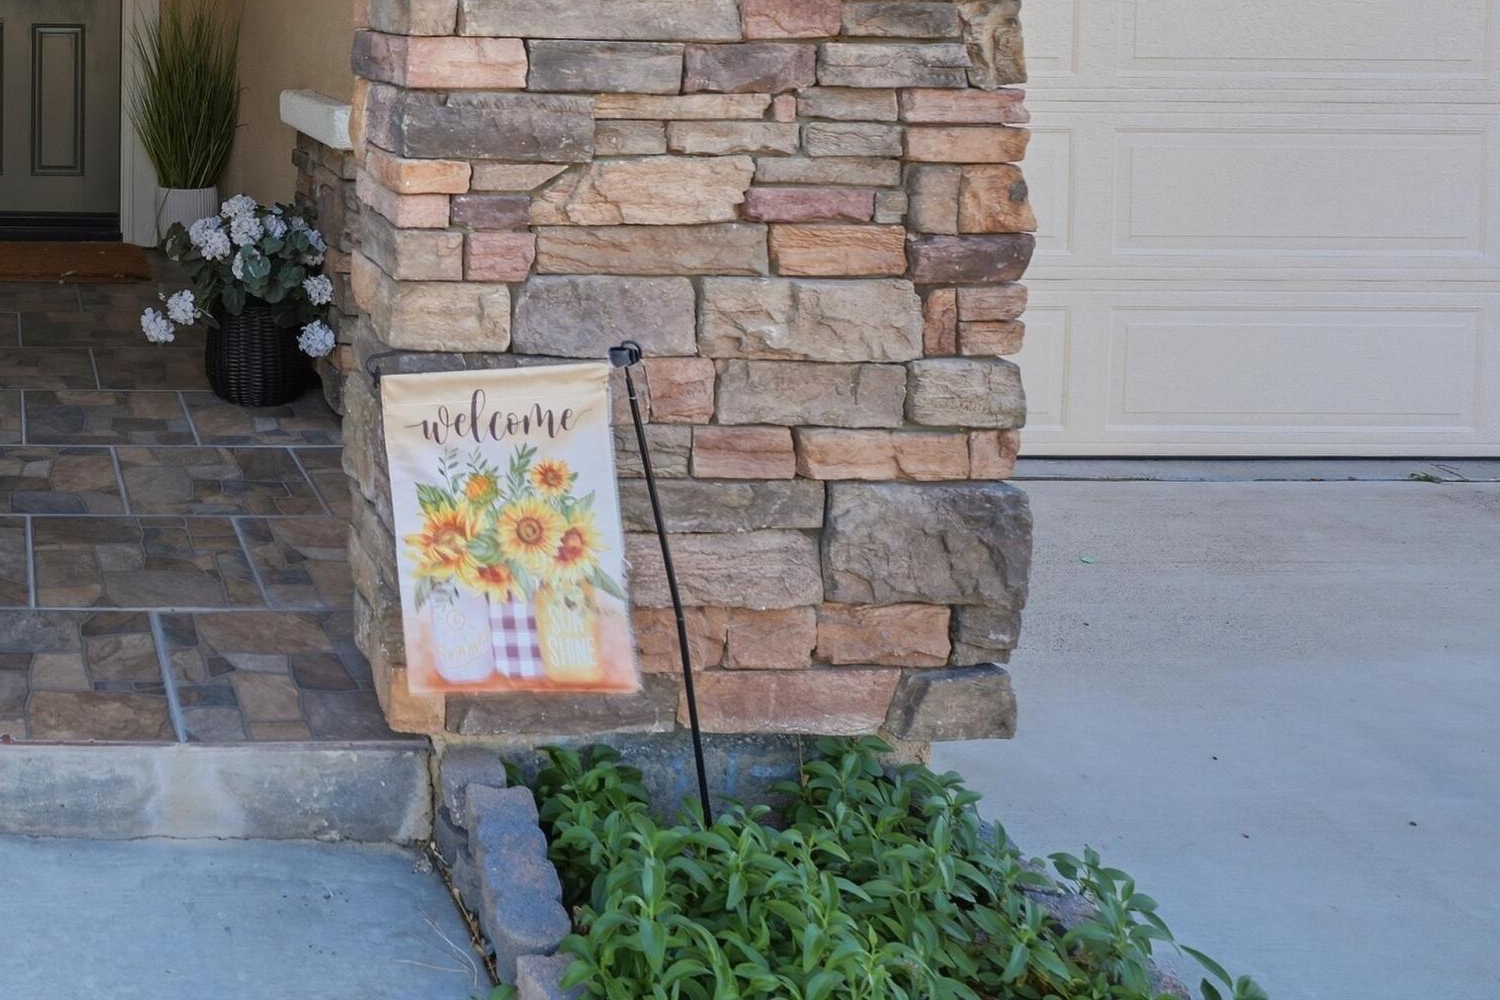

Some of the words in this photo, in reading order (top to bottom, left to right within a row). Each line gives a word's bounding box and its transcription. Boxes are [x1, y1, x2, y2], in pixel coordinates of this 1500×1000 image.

[405, 388, 593, 445] welcome
[548, 605, 585, 633] SUN
[547, 635, 598, 668] SHINE
